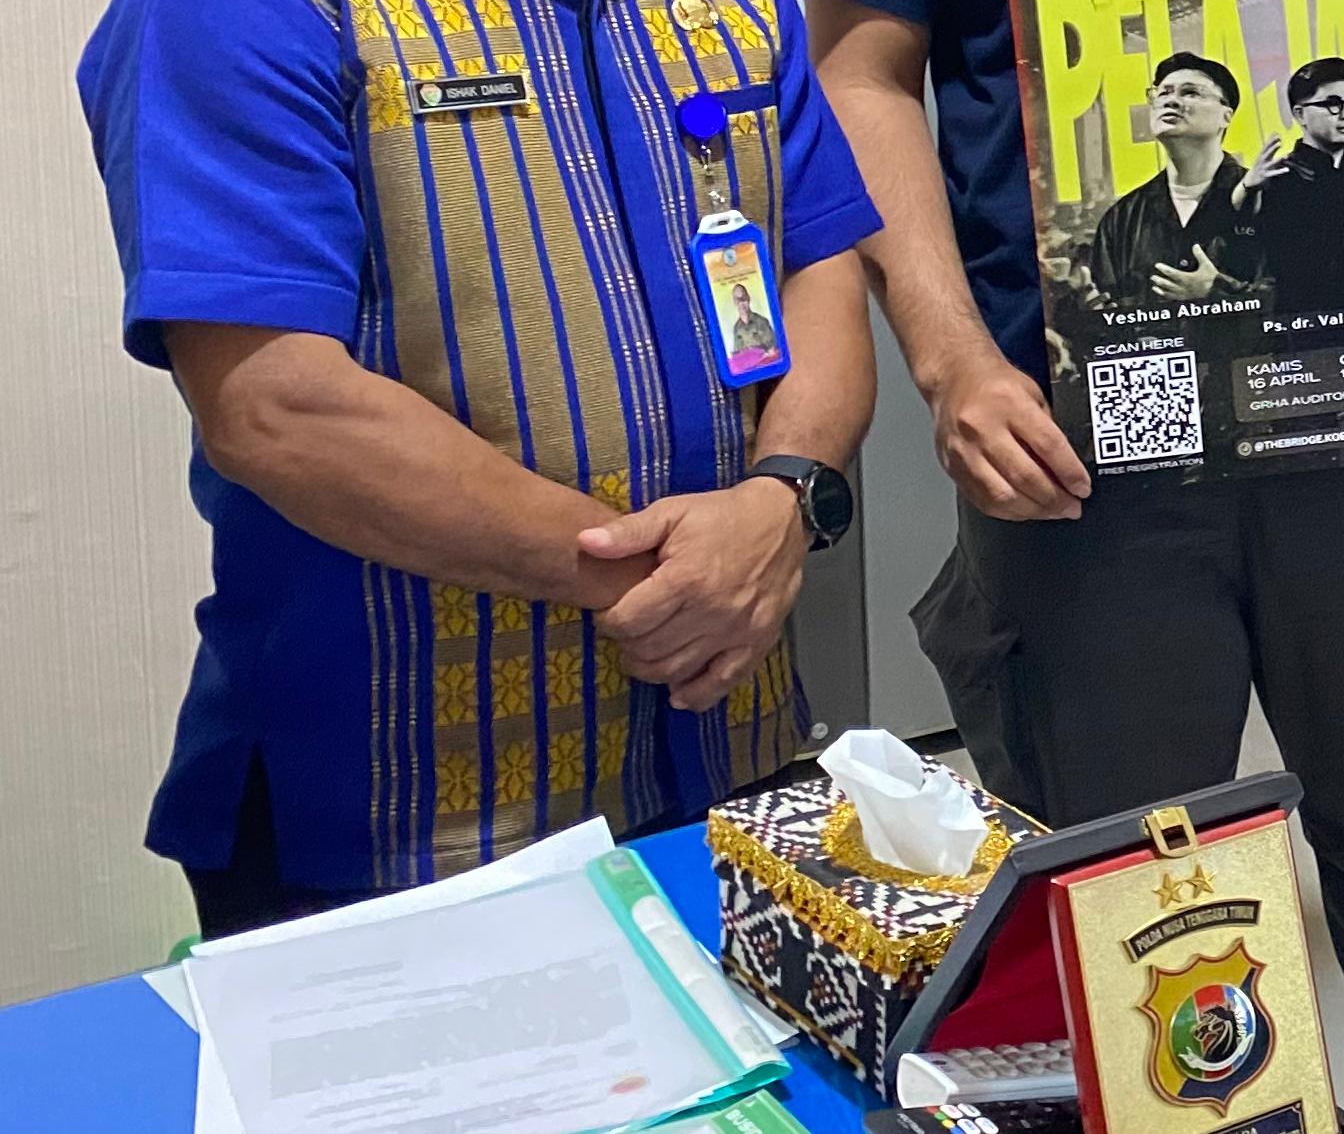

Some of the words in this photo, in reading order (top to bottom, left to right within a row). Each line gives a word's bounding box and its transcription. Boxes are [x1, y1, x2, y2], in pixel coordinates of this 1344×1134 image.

[1102, 309, 1171, 325] Yeshua
[1177, 298, 1261, 318] Abraham
[1263, 321, 1287, 332] Ps.
[1291, 318, 1315, 330] dr.
[1094, 342, 1139, 356] SCAN
[1142, 337, 1185, 350] HERE
[1246, 359, 1303, 376] KAMIS
[1247, 379, 1266, 390] 16
[1269, 371, 1321, 387] APRIL
[1250, 397, 1289, 411] GRHA
